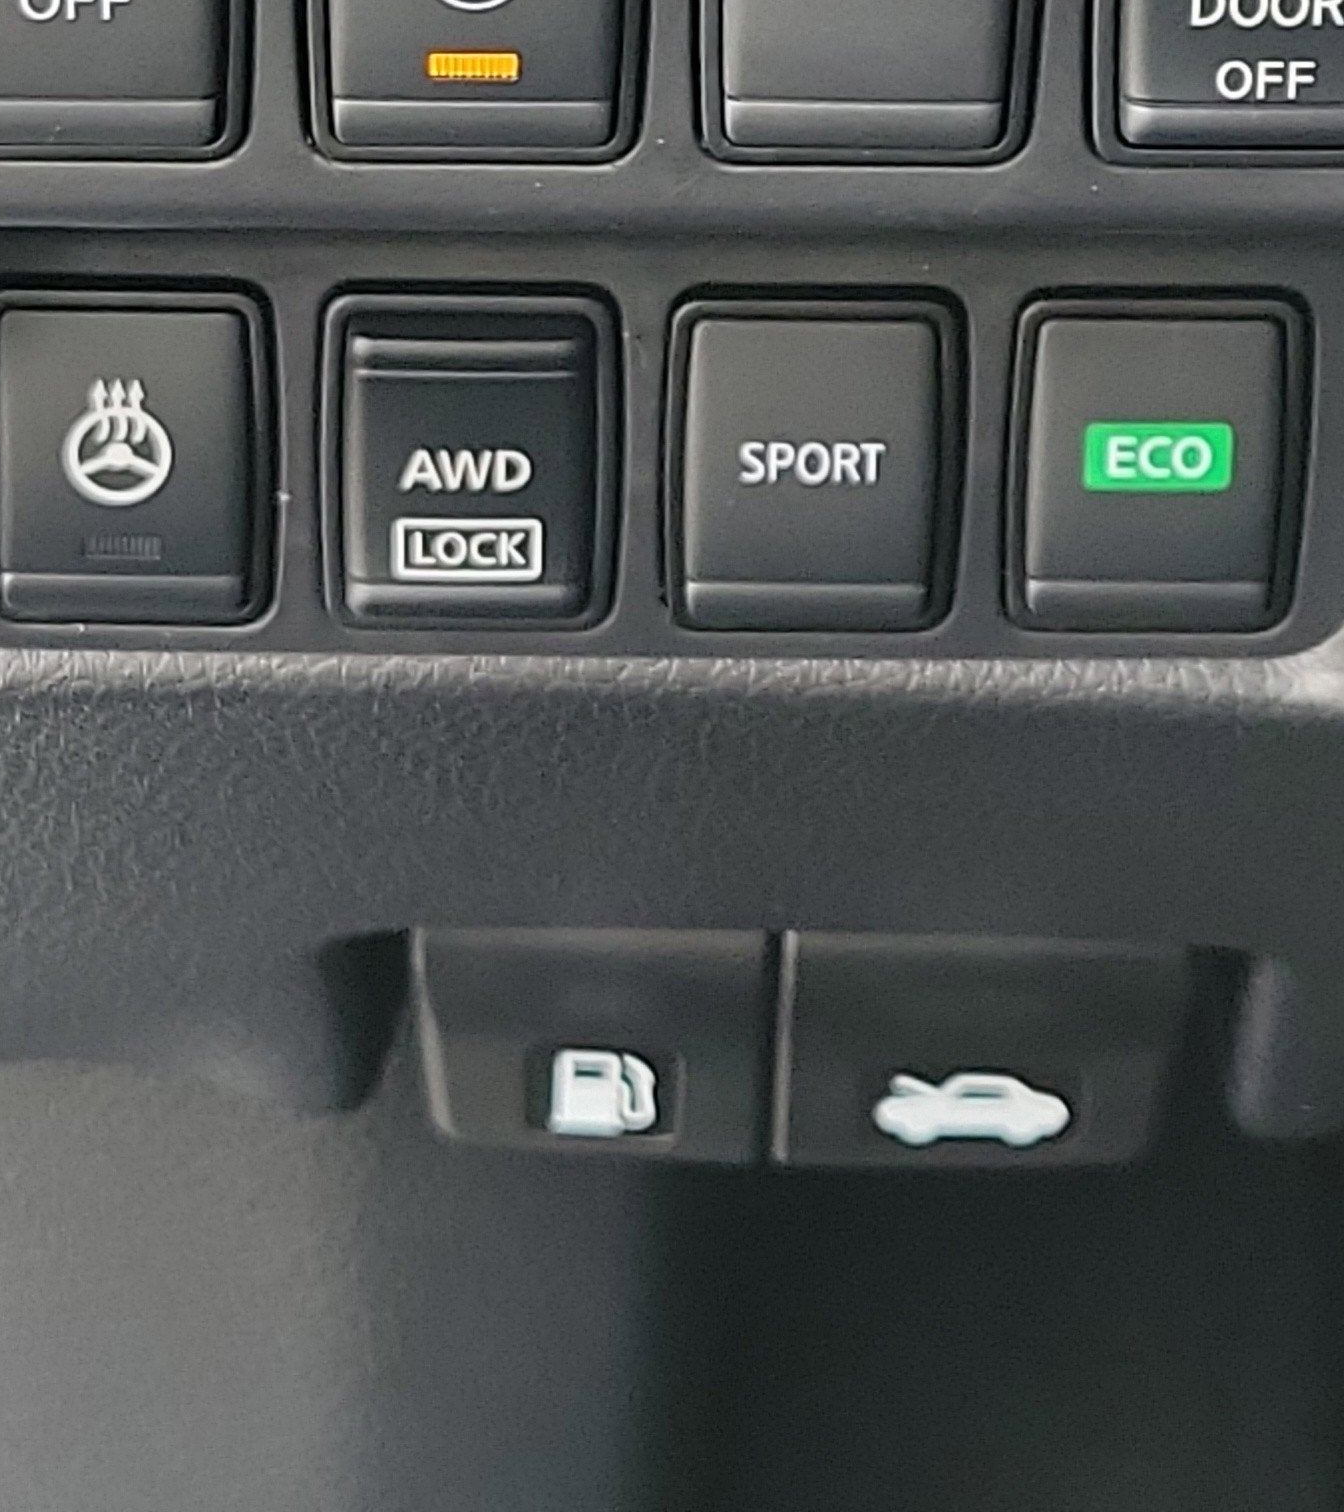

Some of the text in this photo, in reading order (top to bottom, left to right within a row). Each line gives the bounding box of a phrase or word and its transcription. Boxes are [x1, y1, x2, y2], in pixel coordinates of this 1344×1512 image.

[1215, 60, 1316, 100] OFF
[400, 449, 531, 492] AWD
[740, 441, 886, 484] SPORT
[1105, 435, 1212, 479] ECO
[410, 530, 526, 567] LOCK
